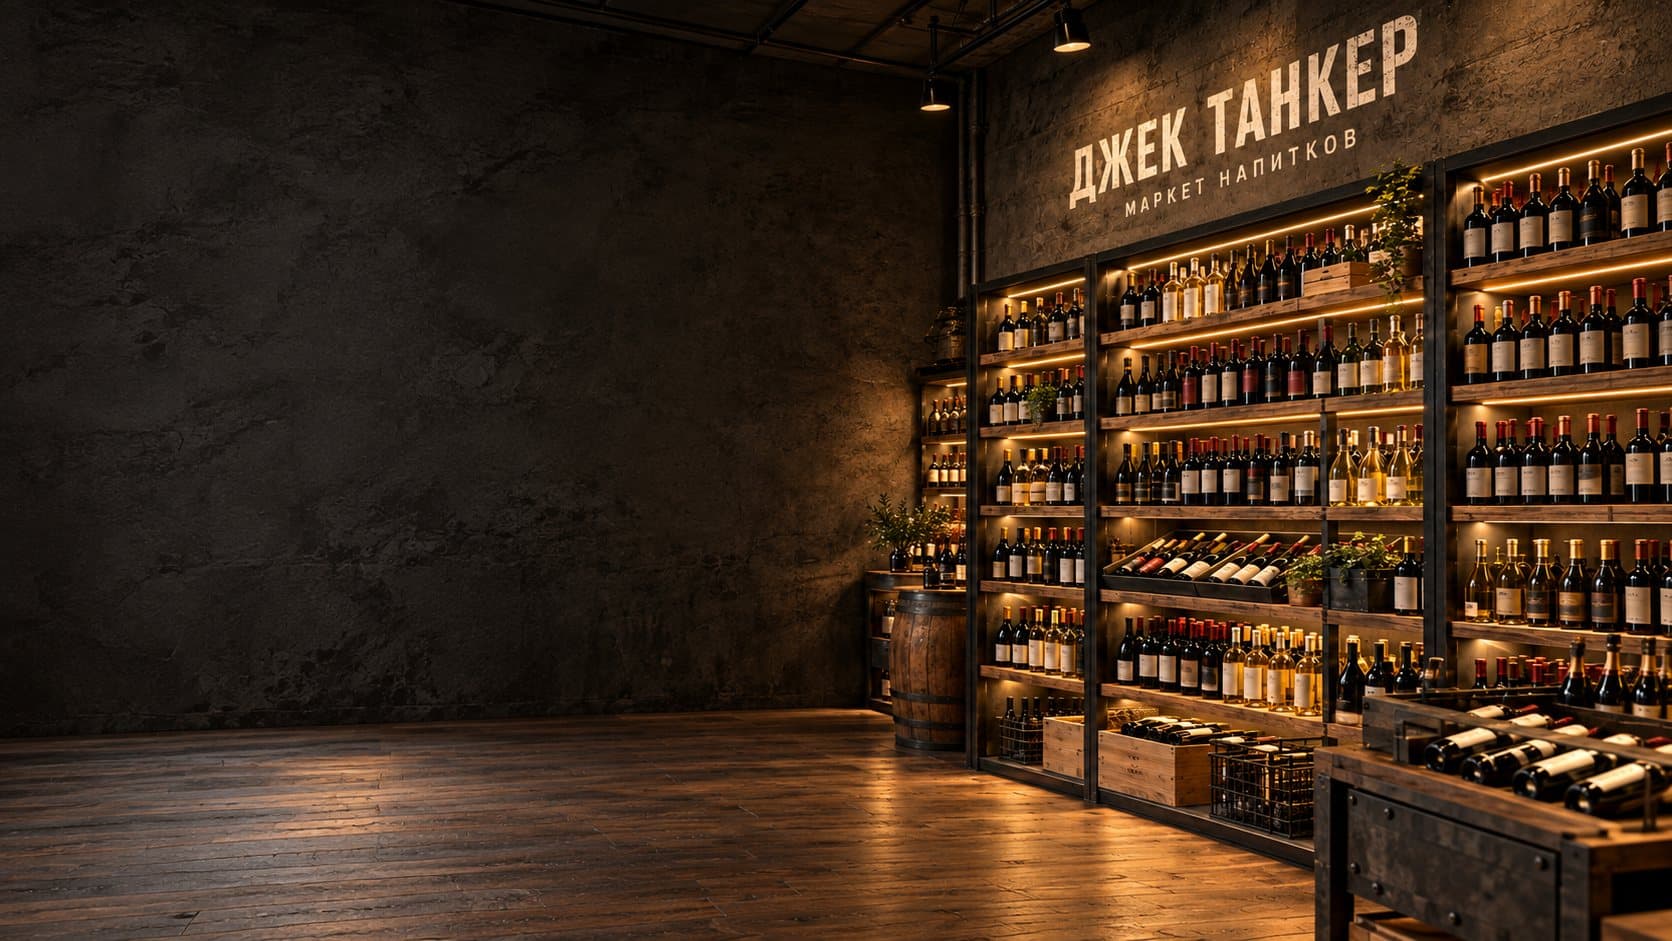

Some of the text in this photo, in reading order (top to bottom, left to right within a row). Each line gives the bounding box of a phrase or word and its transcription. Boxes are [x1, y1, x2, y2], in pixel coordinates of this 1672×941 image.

[1069, 14, 1418, 209] ДЖЕК ТАНКЕР
[1125, 128, 1357, 218] МАРКЕТ НАПИТКОВ
